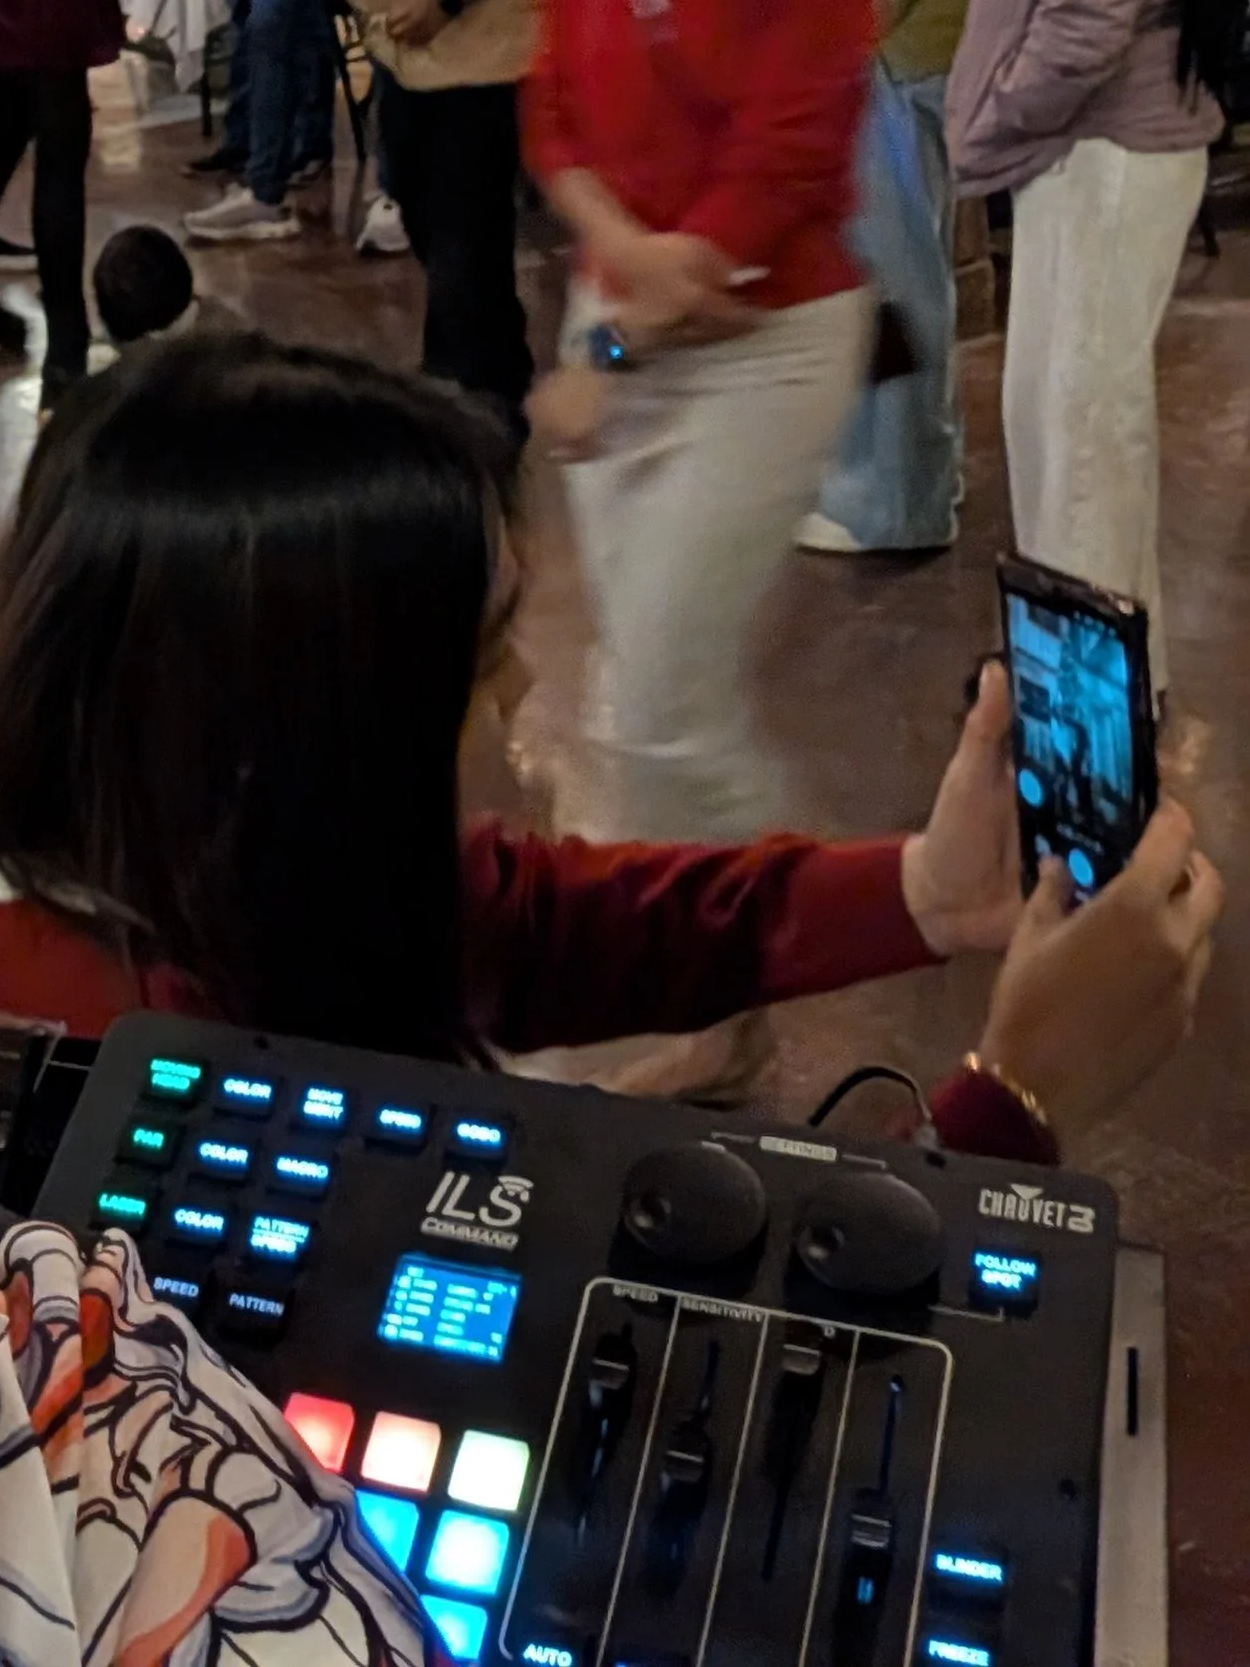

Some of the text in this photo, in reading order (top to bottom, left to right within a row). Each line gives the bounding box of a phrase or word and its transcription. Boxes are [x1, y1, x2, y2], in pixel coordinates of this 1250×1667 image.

[223, 1078, 272, 1098] COLOR
[134, 1128, 164, 1149] PAR
[199, 1142, 249, 1163] COLOR
[276, 1156, 329, 1179] MACRO
[425, 1170, 534, 1227] ILS
[978, 1188, 1067, 1229] CHAUVET
[174, 1208, 224, 1230] COLOR
[254, 1216, 310, 1241] PATTERN
[975, 1252, 1037, 1277] FOLLOW
[153, 1277, 200, 1298] SPEED
[229, 1293, 285, 1317] PATTERN
[523, 1644, 572, 1667] AUTO
